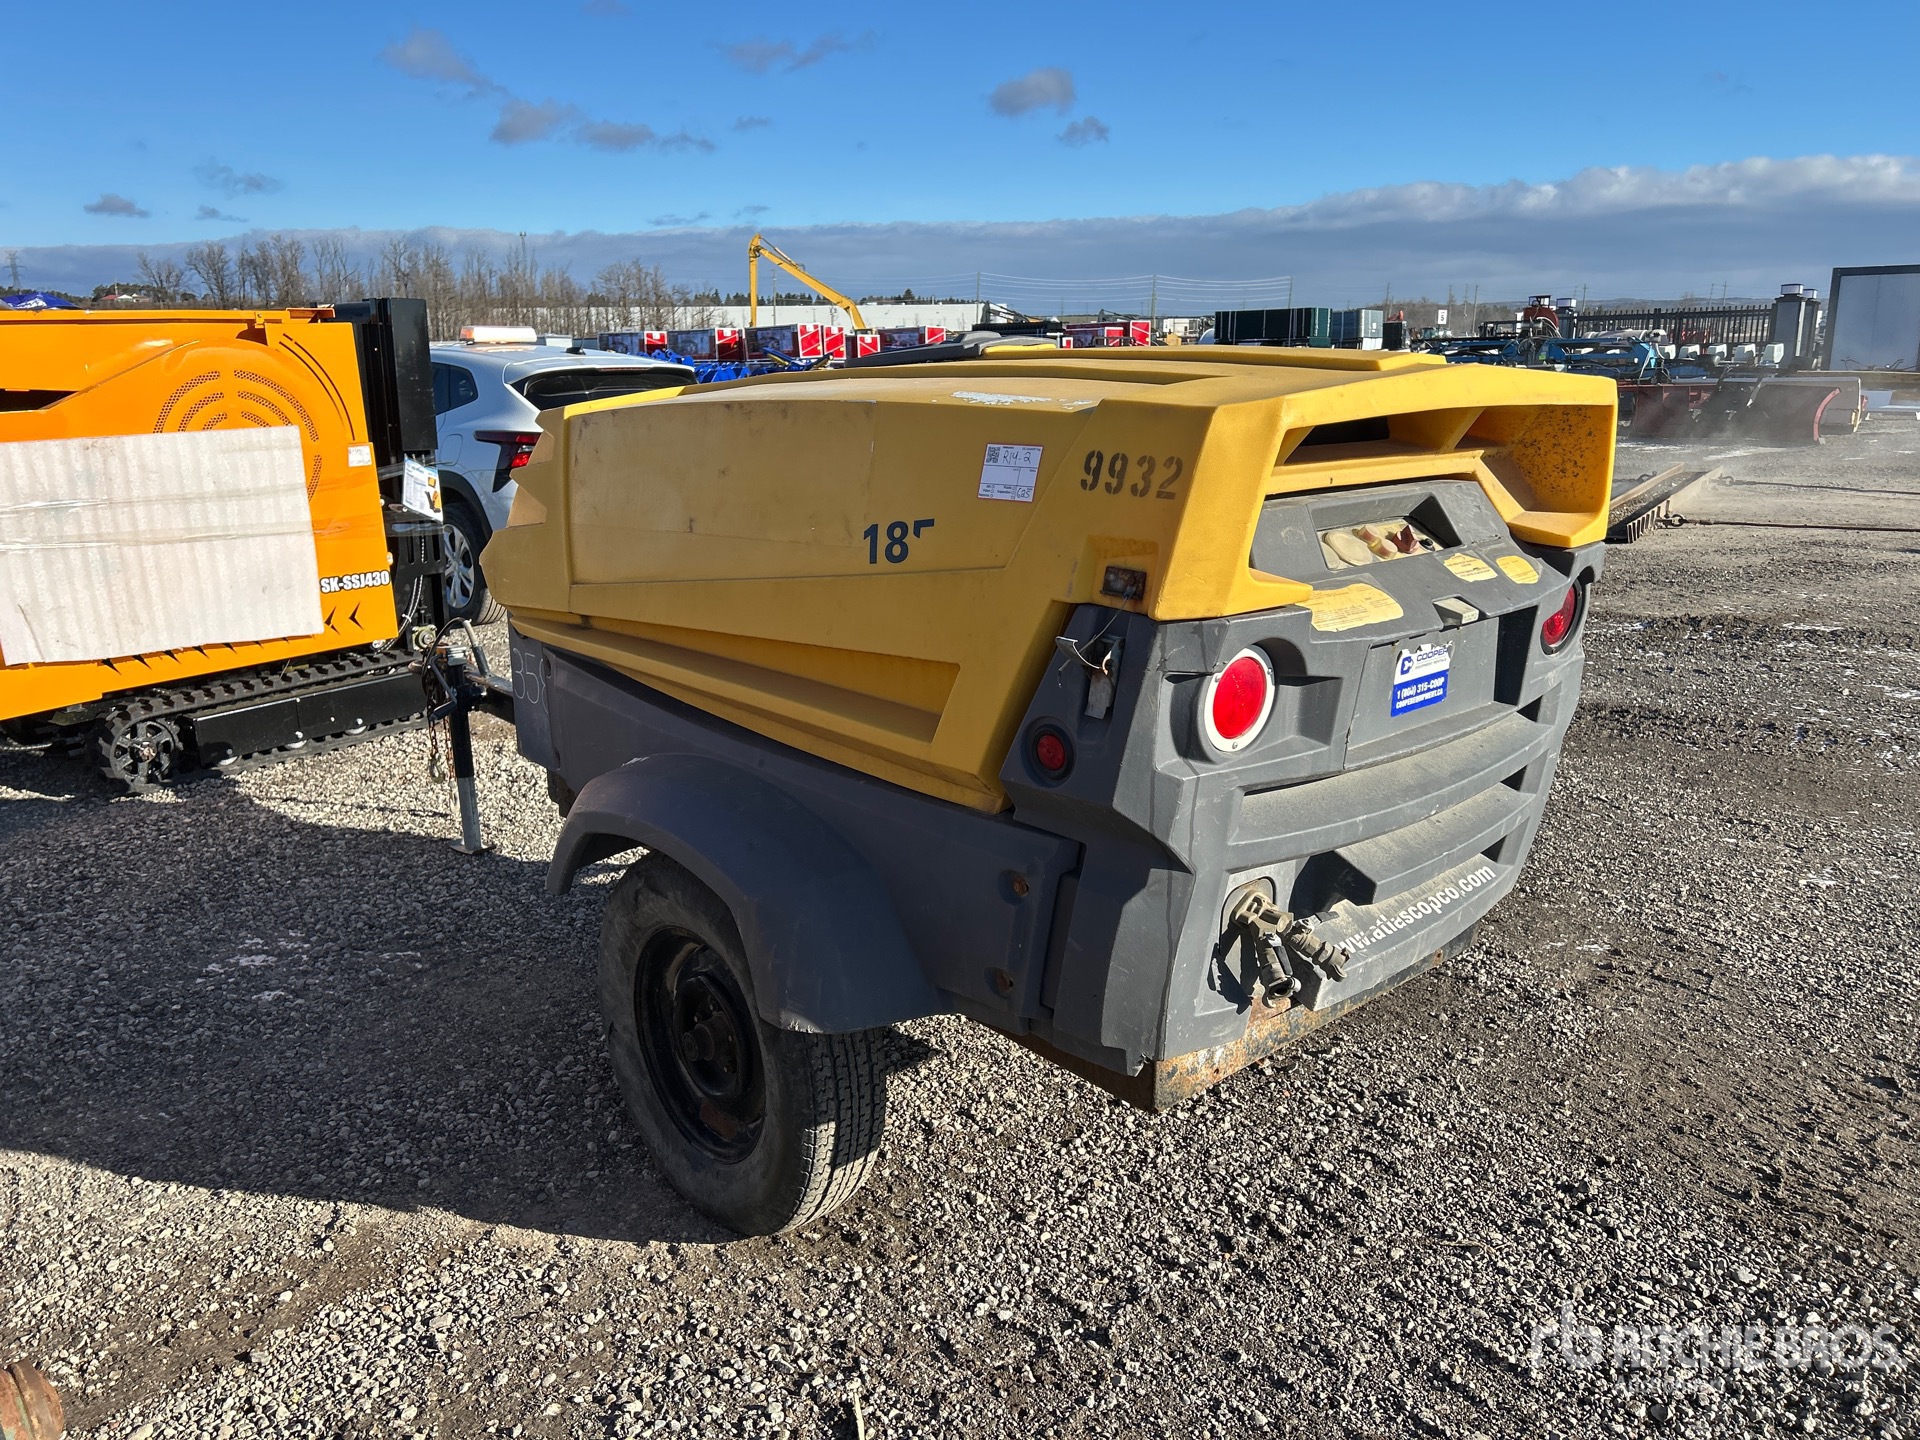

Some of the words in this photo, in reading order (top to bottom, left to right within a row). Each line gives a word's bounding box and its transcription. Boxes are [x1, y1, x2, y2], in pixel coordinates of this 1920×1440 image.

[1080, 450, 1183, 500] 9932
[320, 570, 390, 594] SK-SSJ430
[1334, 865, 1497, 954] ww.atlascopco.com
